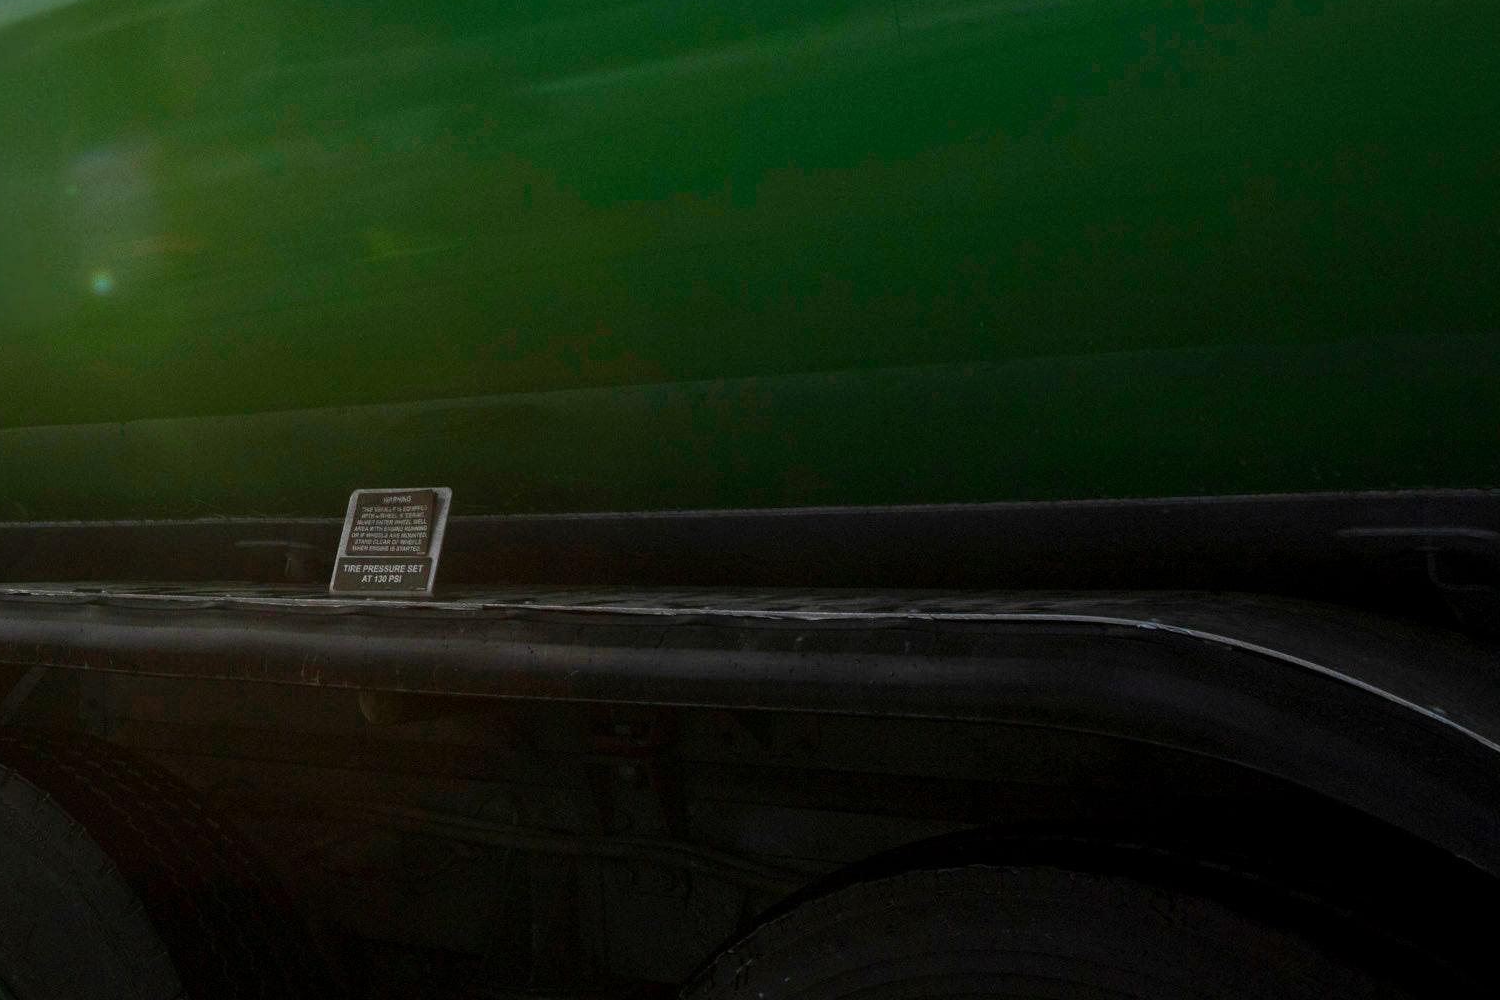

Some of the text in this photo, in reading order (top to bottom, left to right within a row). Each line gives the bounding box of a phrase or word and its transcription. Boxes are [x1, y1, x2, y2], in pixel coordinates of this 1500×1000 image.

[343, 564, 424, 573] TIRE PRESSURE SET
[361, 575, 403, 583] AT 130 PSI
